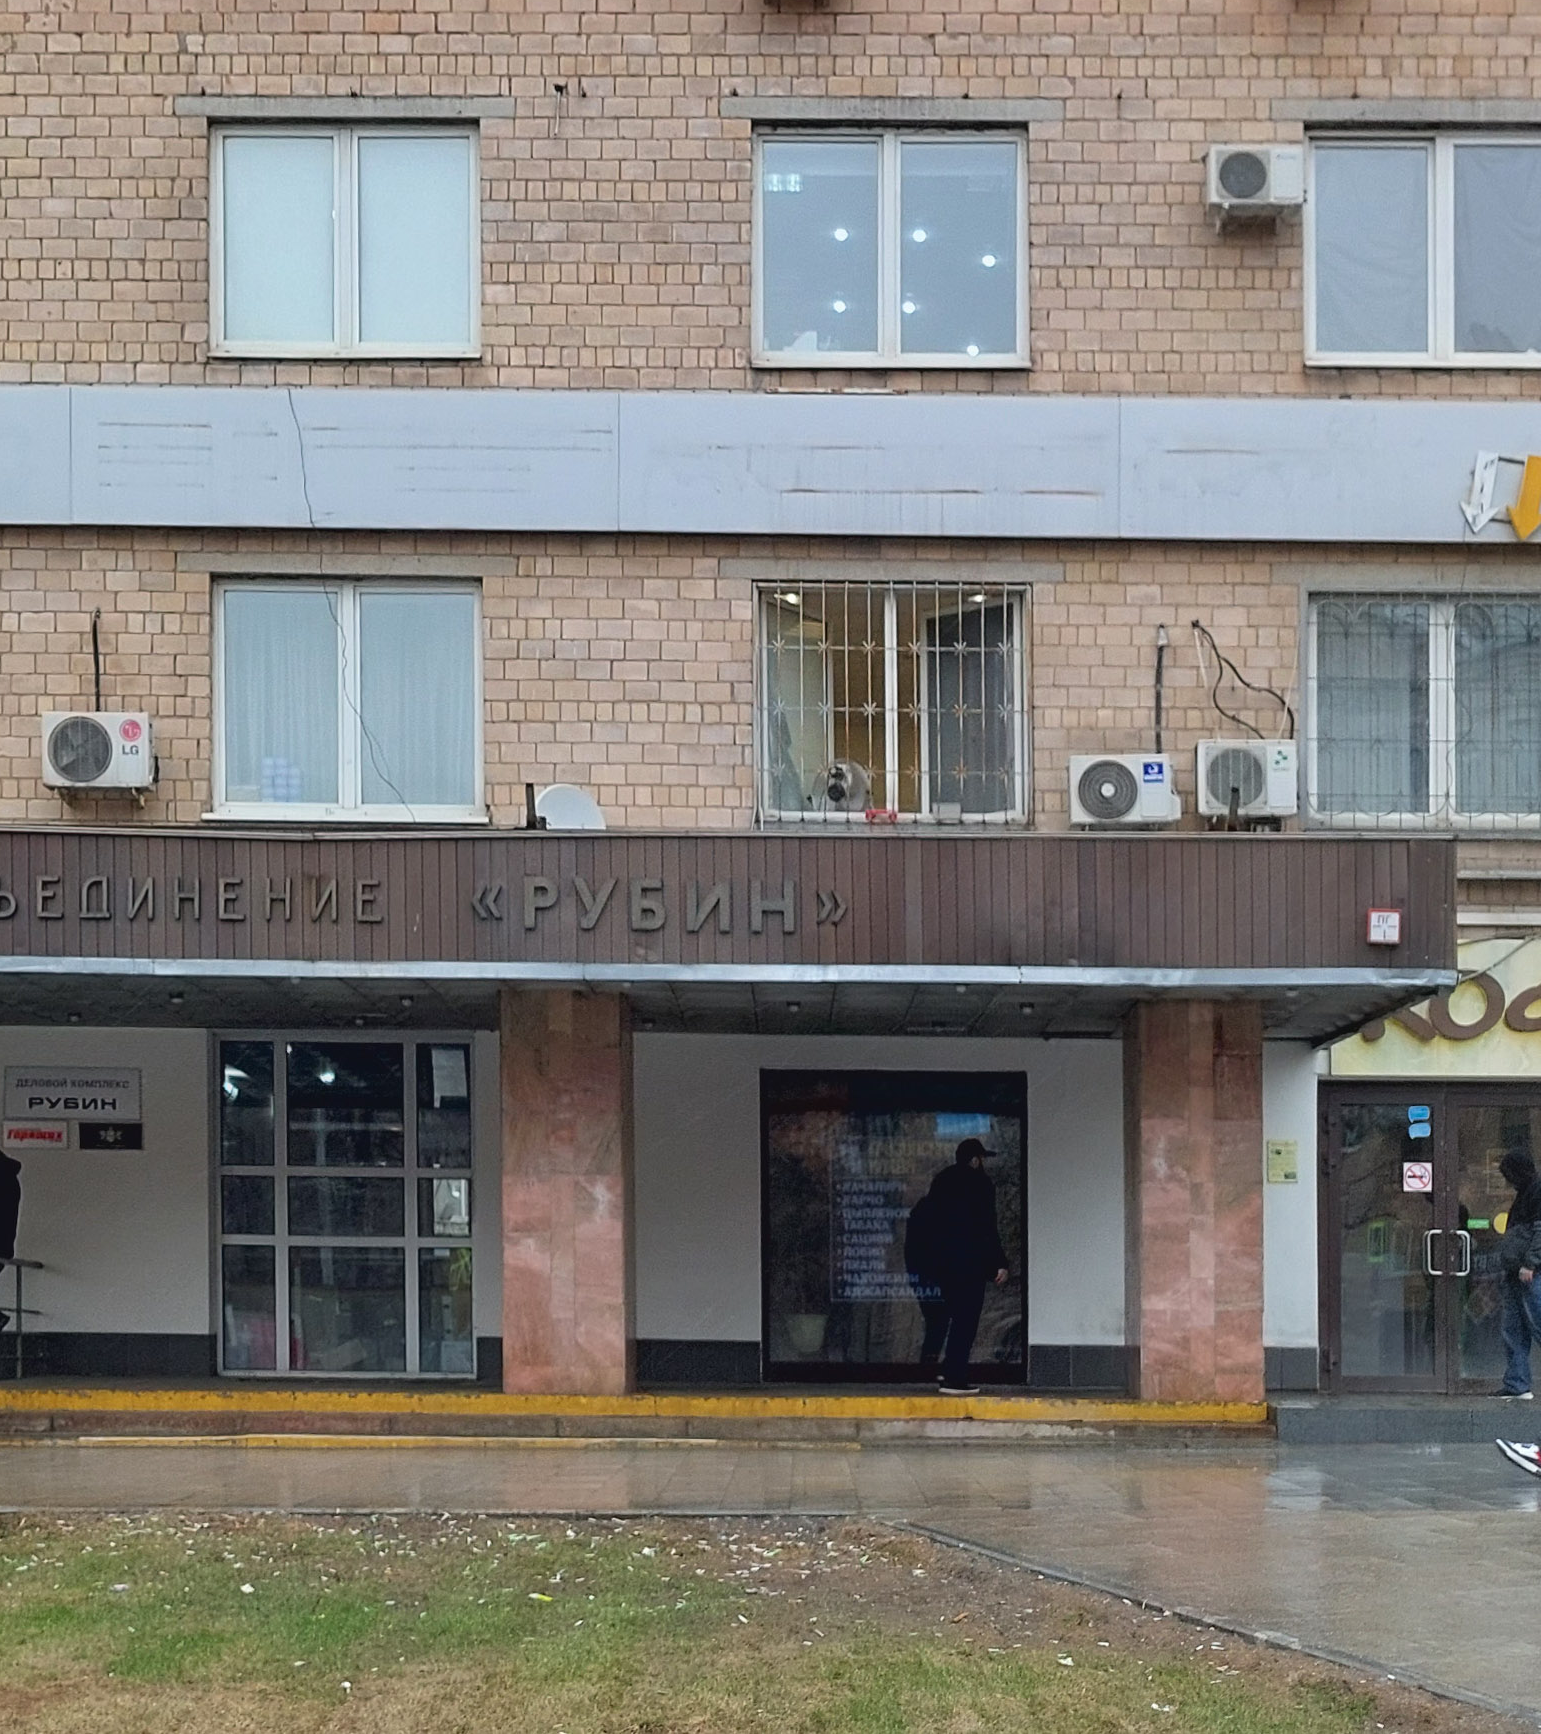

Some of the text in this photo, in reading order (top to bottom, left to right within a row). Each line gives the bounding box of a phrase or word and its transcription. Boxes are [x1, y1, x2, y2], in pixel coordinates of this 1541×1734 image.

[121, 744, 139, 757] LG
[472, 874, 850, 934] «РУБИН»
[15, 1078, 130, 1089] ДЕЛОВОЙ КОМПЛЕКС
[28, 1097, 117, 1111] РУБИН
